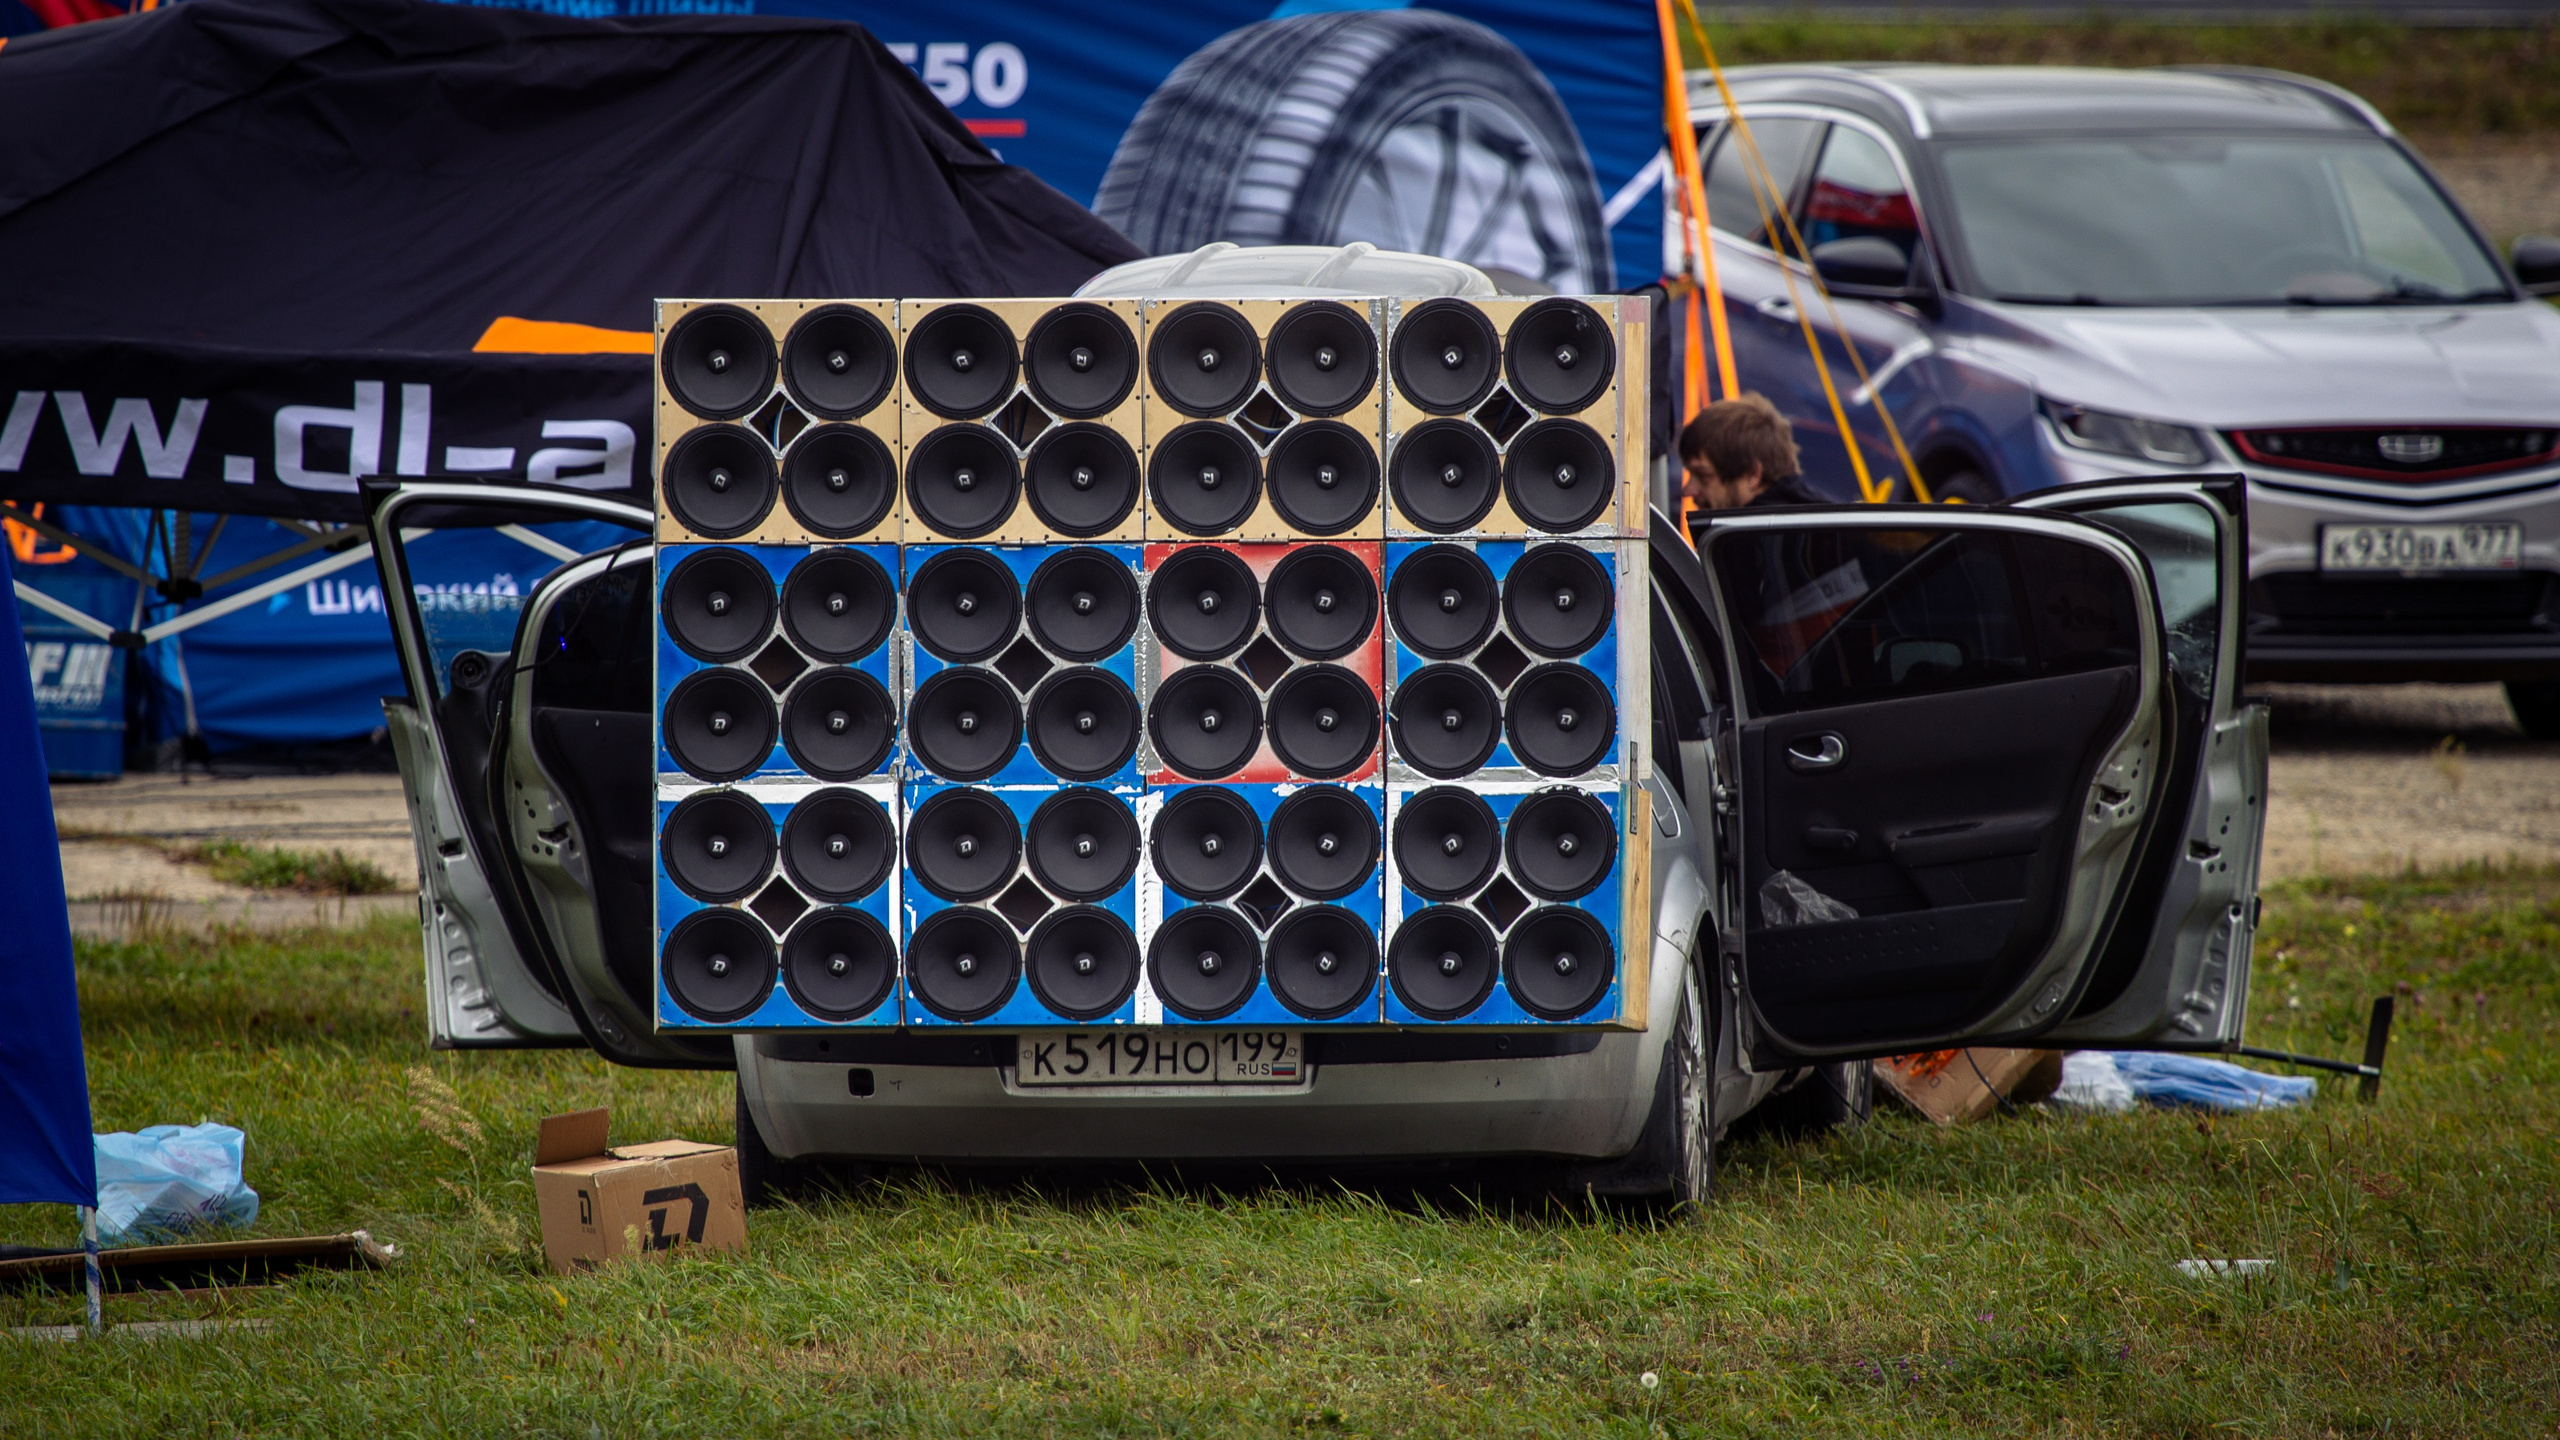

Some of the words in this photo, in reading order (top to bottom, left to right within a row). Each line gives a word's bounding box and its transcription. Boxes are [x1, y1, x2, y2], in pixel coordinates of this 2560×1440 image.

[885, 42, 1028, 108] 50
[306, 573, 520, 614] Шиокий
[1221, 1033, 1287, 1061] 199
[1237, 1063, 1270, 1075] RUS
